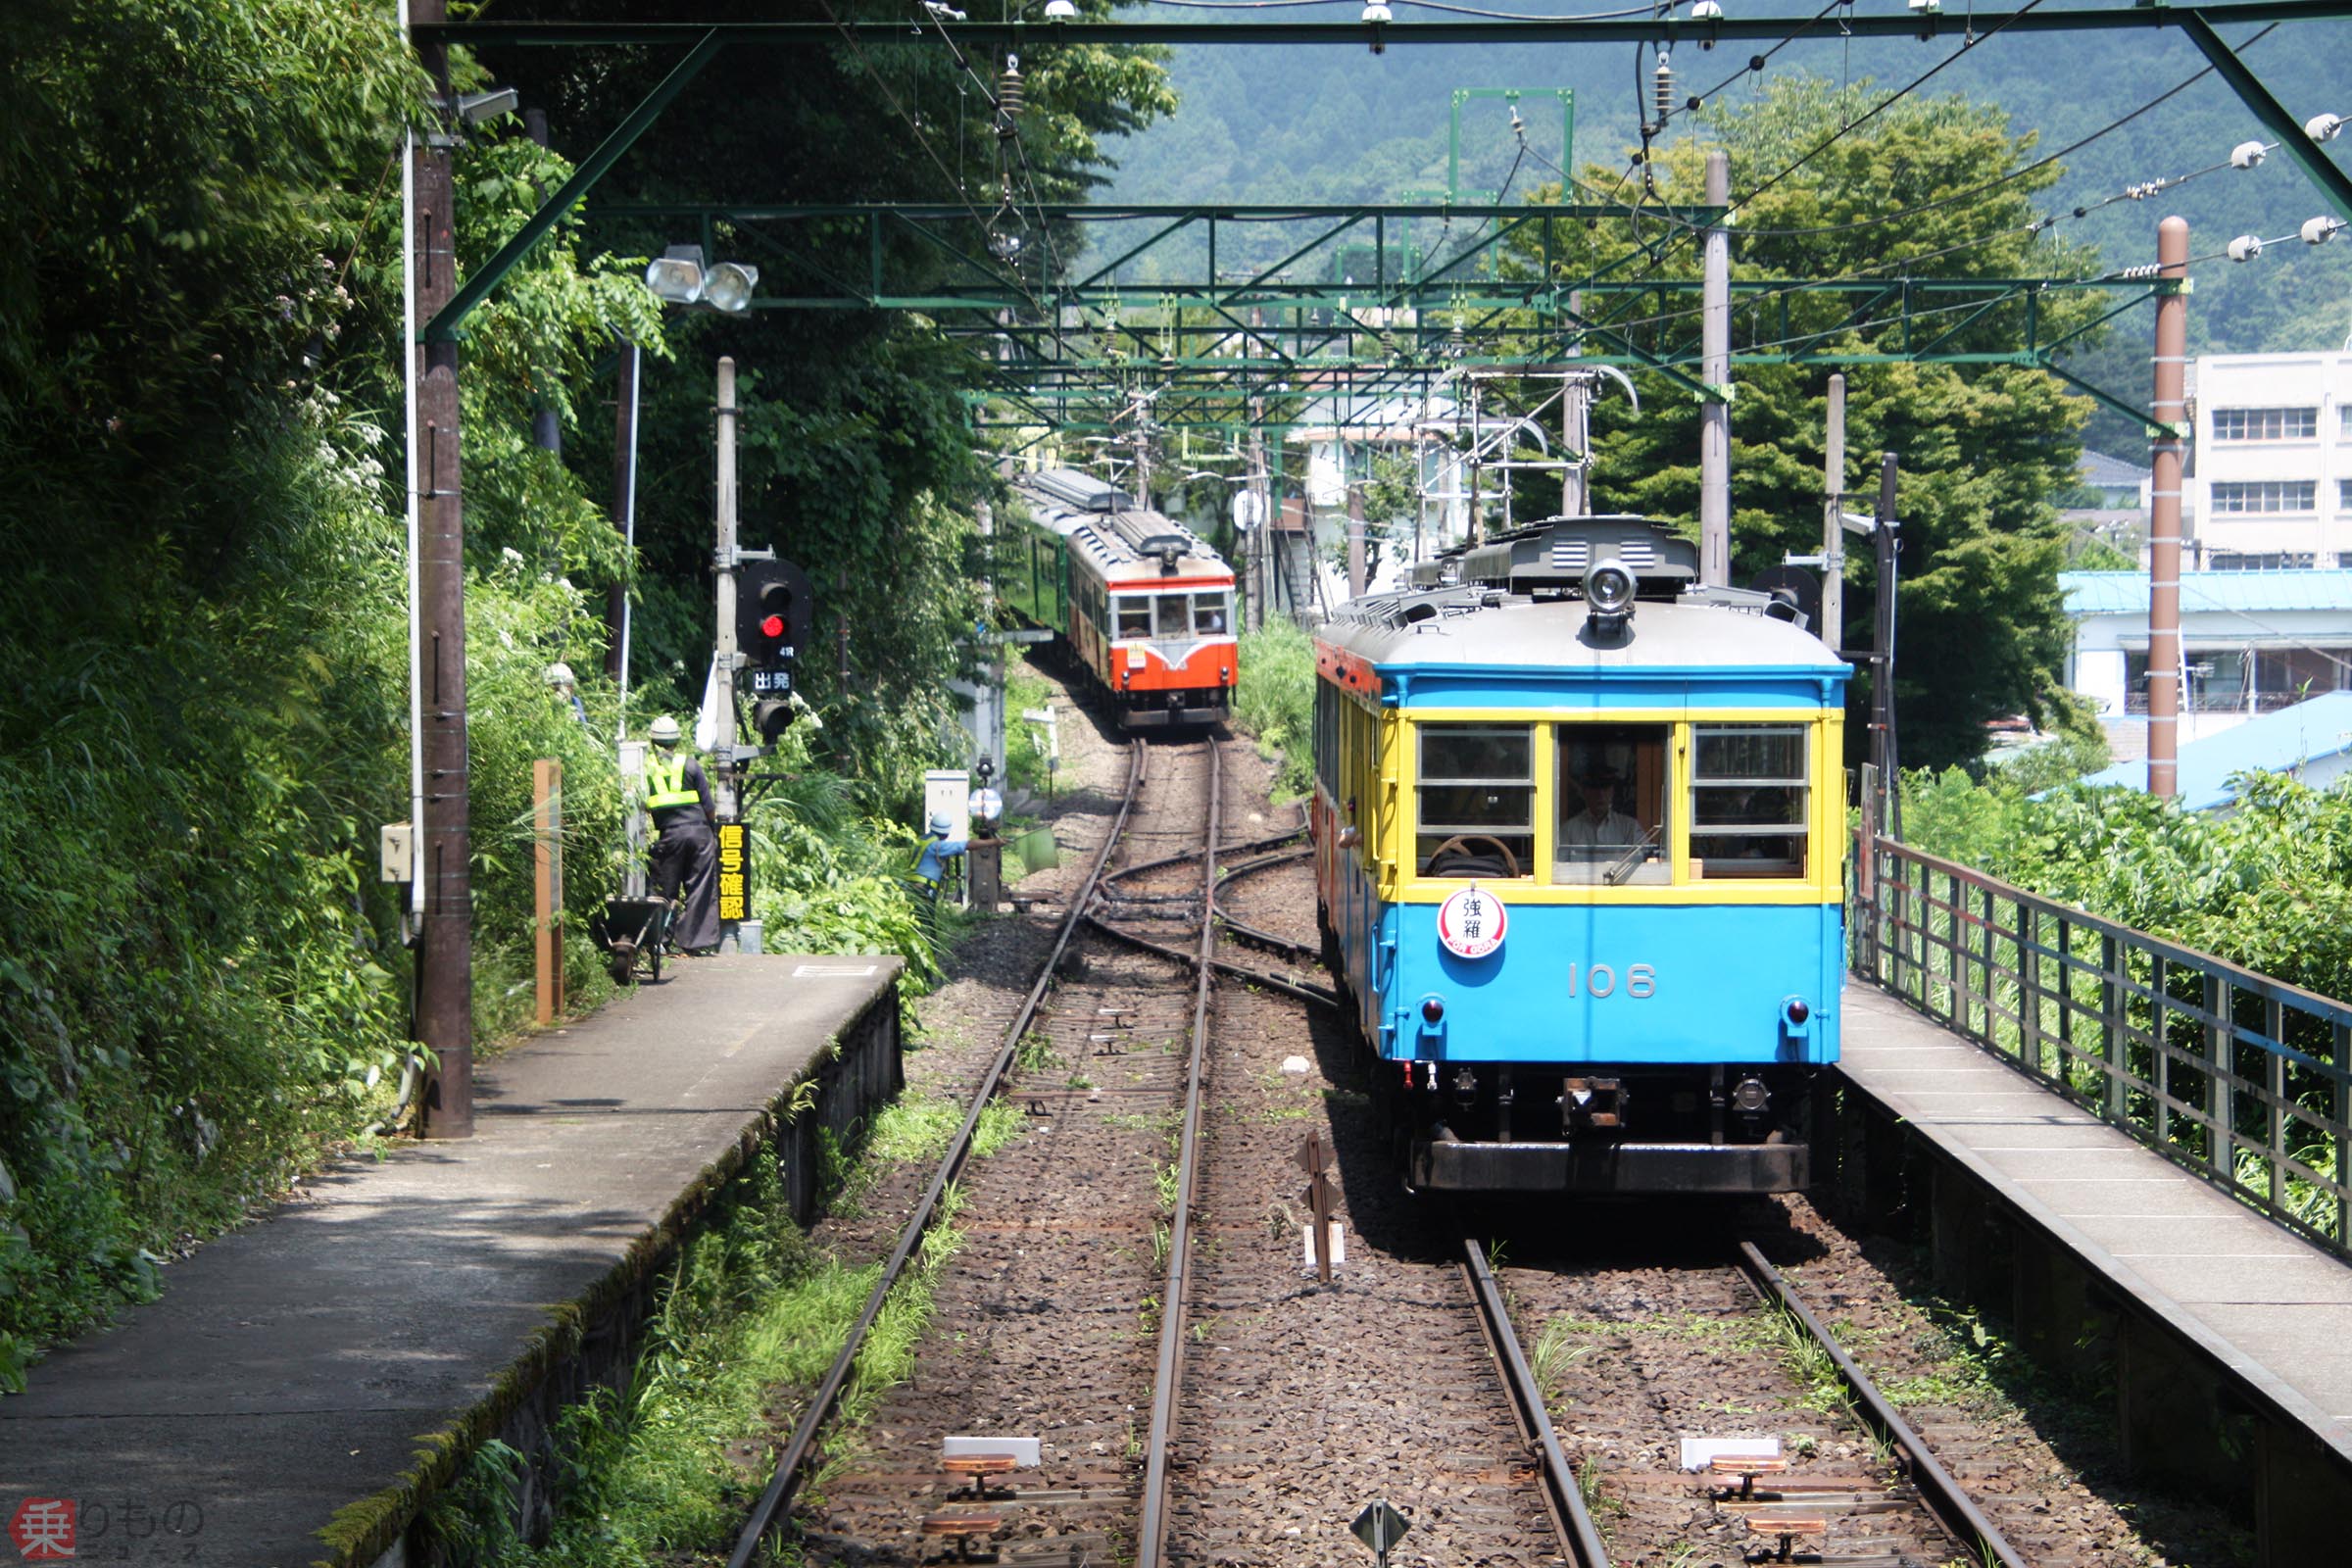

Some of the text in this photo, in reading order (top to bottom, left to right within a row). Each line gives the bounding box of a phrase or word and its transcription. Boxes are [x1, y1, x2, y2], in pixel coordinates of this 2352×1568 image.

[755, 672, 790, 690] 出発
[718, 824, 744, 919] 信号確認
[1463, 898, 1482, 939] 強羅
[1569, 962, 1655, 999] 106
